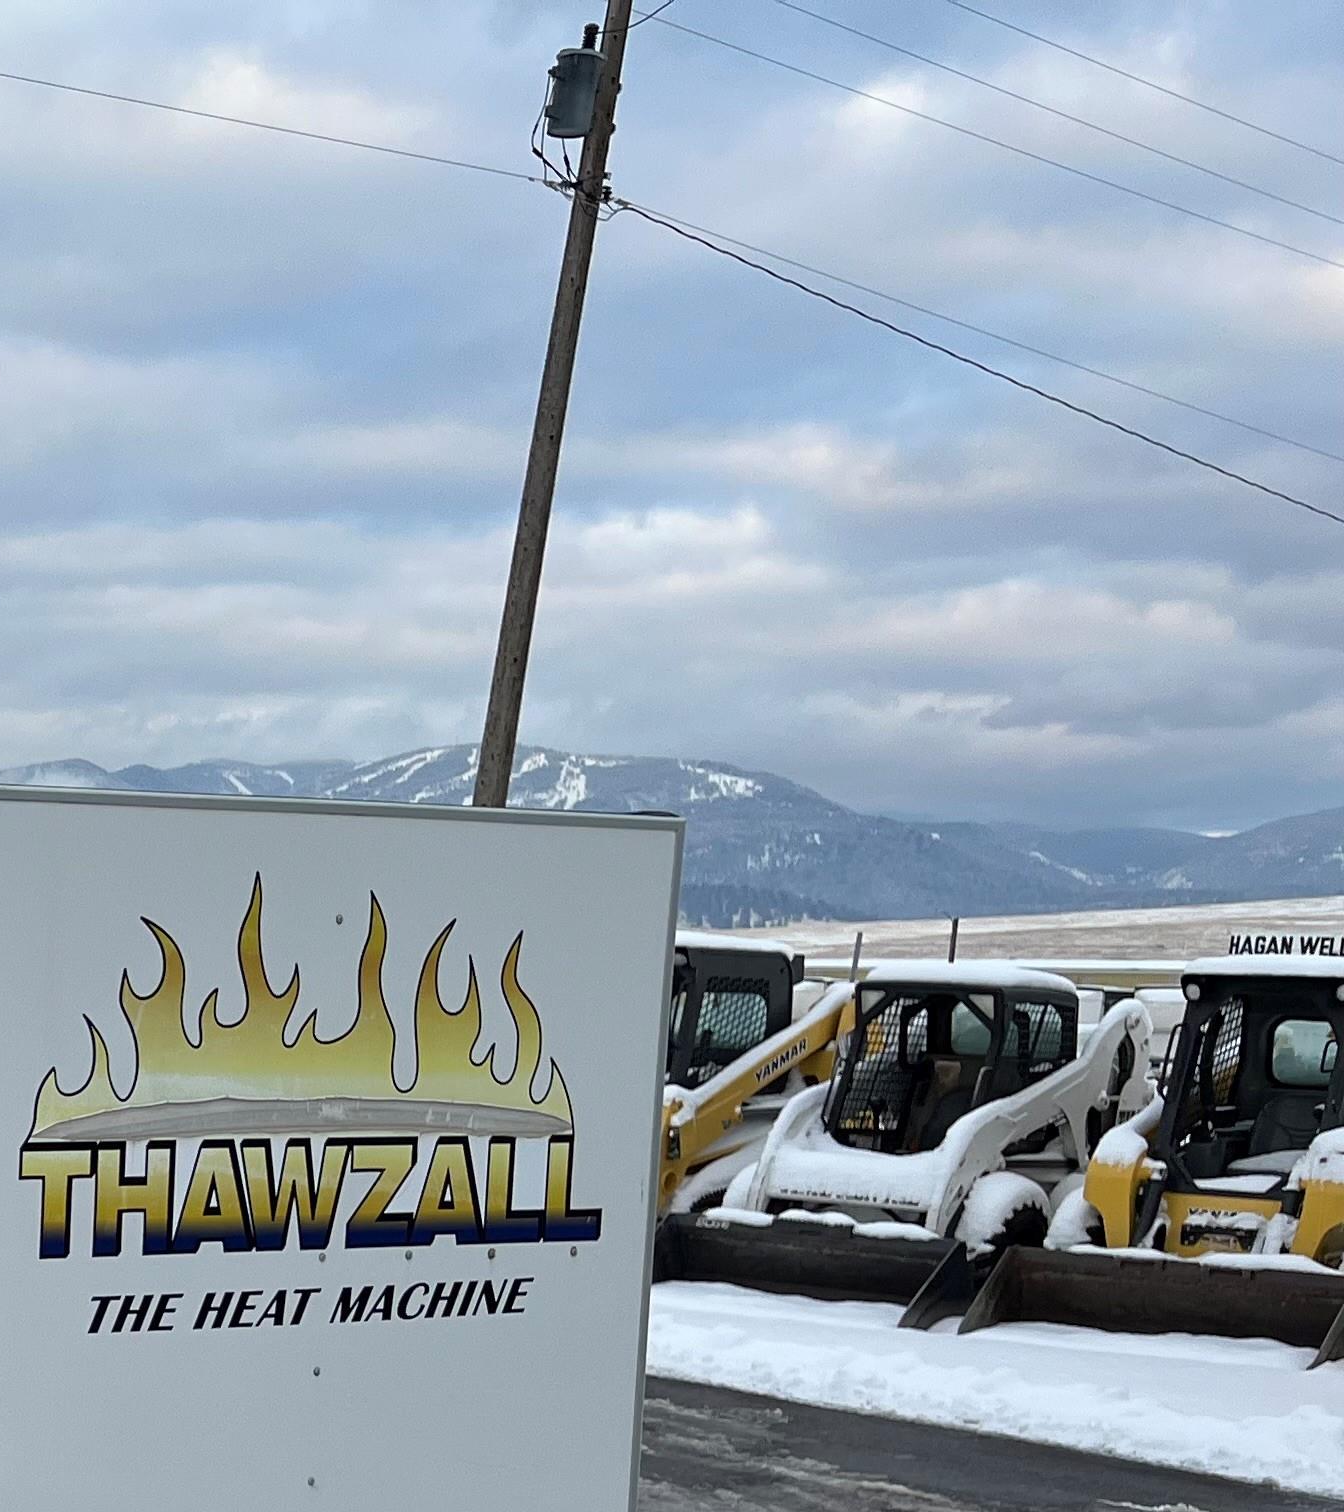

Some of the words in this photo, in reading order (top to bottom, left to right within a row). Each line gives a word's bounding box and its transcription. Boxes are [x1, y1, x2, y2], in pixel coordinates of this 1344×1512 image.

[1228, 935, 1294, 955] HAGAN
[754, 1037, 808, 1083] YANMAR
[18, 1134, 603, 1260] THAWZALL
[87, 1292, 184, 1335] THE
[192, 1287, 322, 1331] HEAT
[329, 1276, 535, 1324] MACHINE
